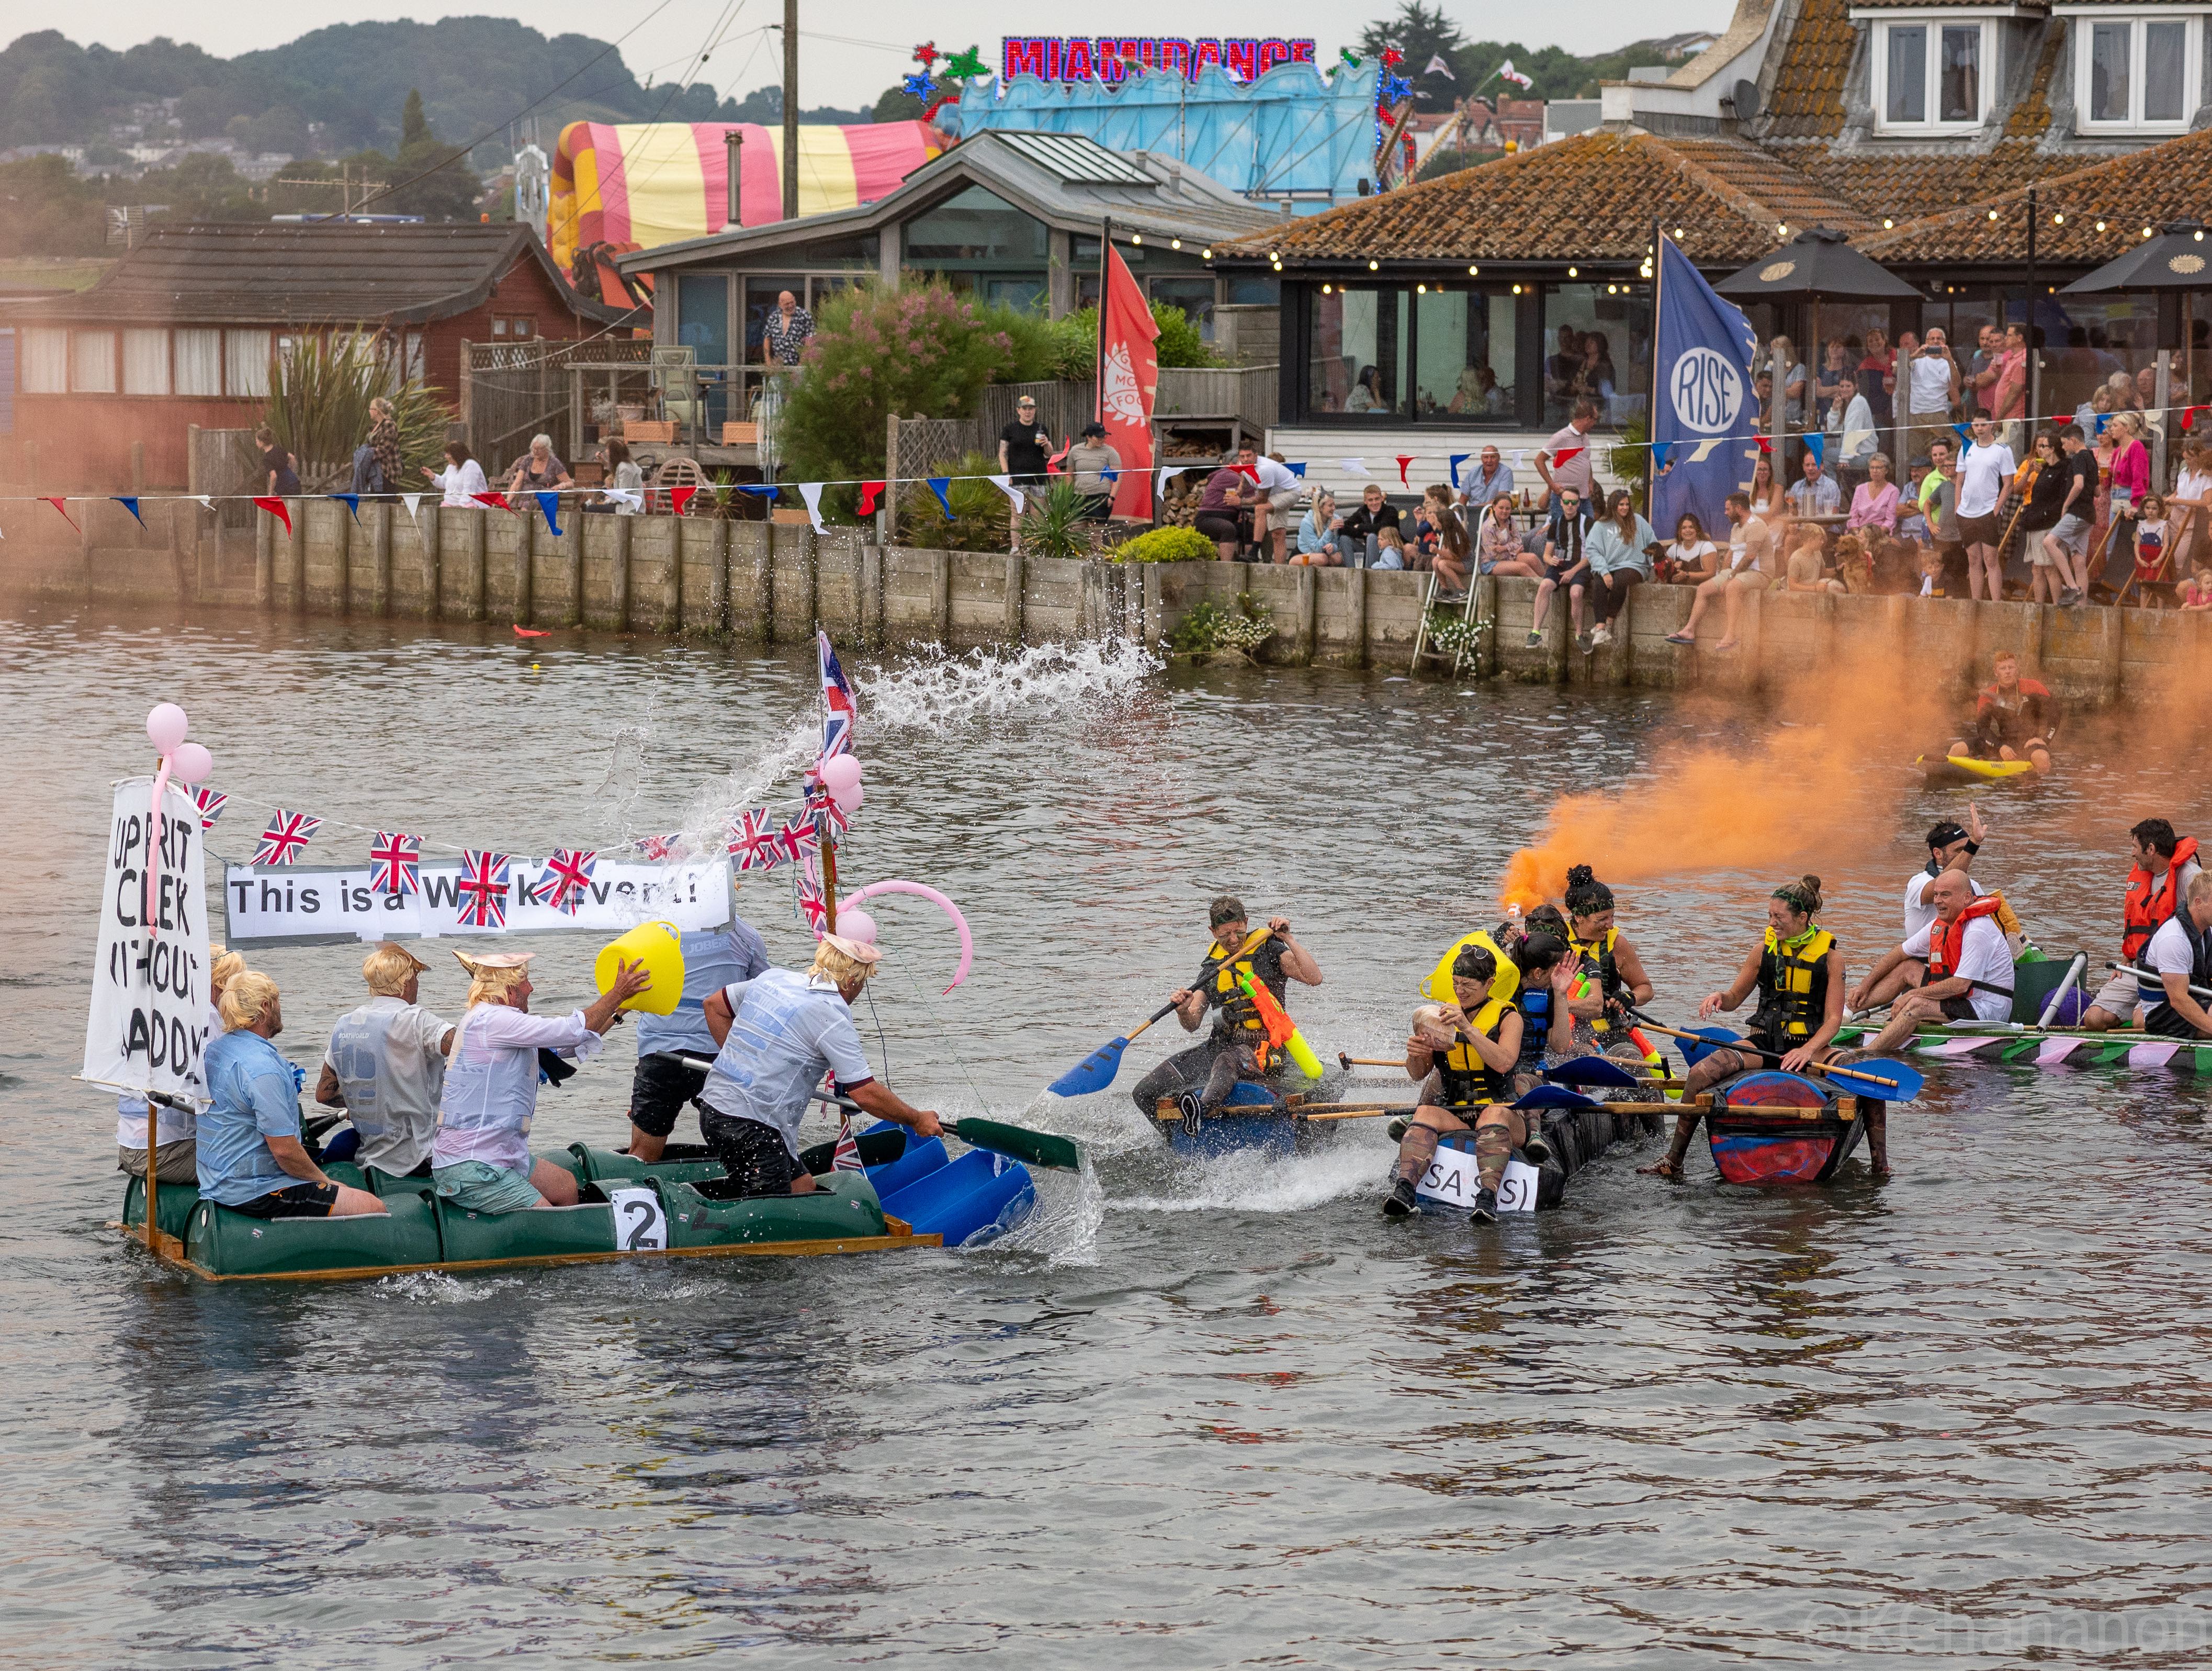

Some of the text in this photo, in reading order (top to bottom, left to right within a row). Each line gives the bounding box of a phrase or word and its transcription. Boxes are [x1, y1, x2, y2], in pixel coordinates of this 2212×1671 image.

[1678, 353, 1734, 427] RISE
[114, 815, 141, 869] UP
[230, 879, 320, 914] This
[341, 879, 372, 913] is
[383, 884, 405, 911] a
[624, 1201, 659, 1249] 2
